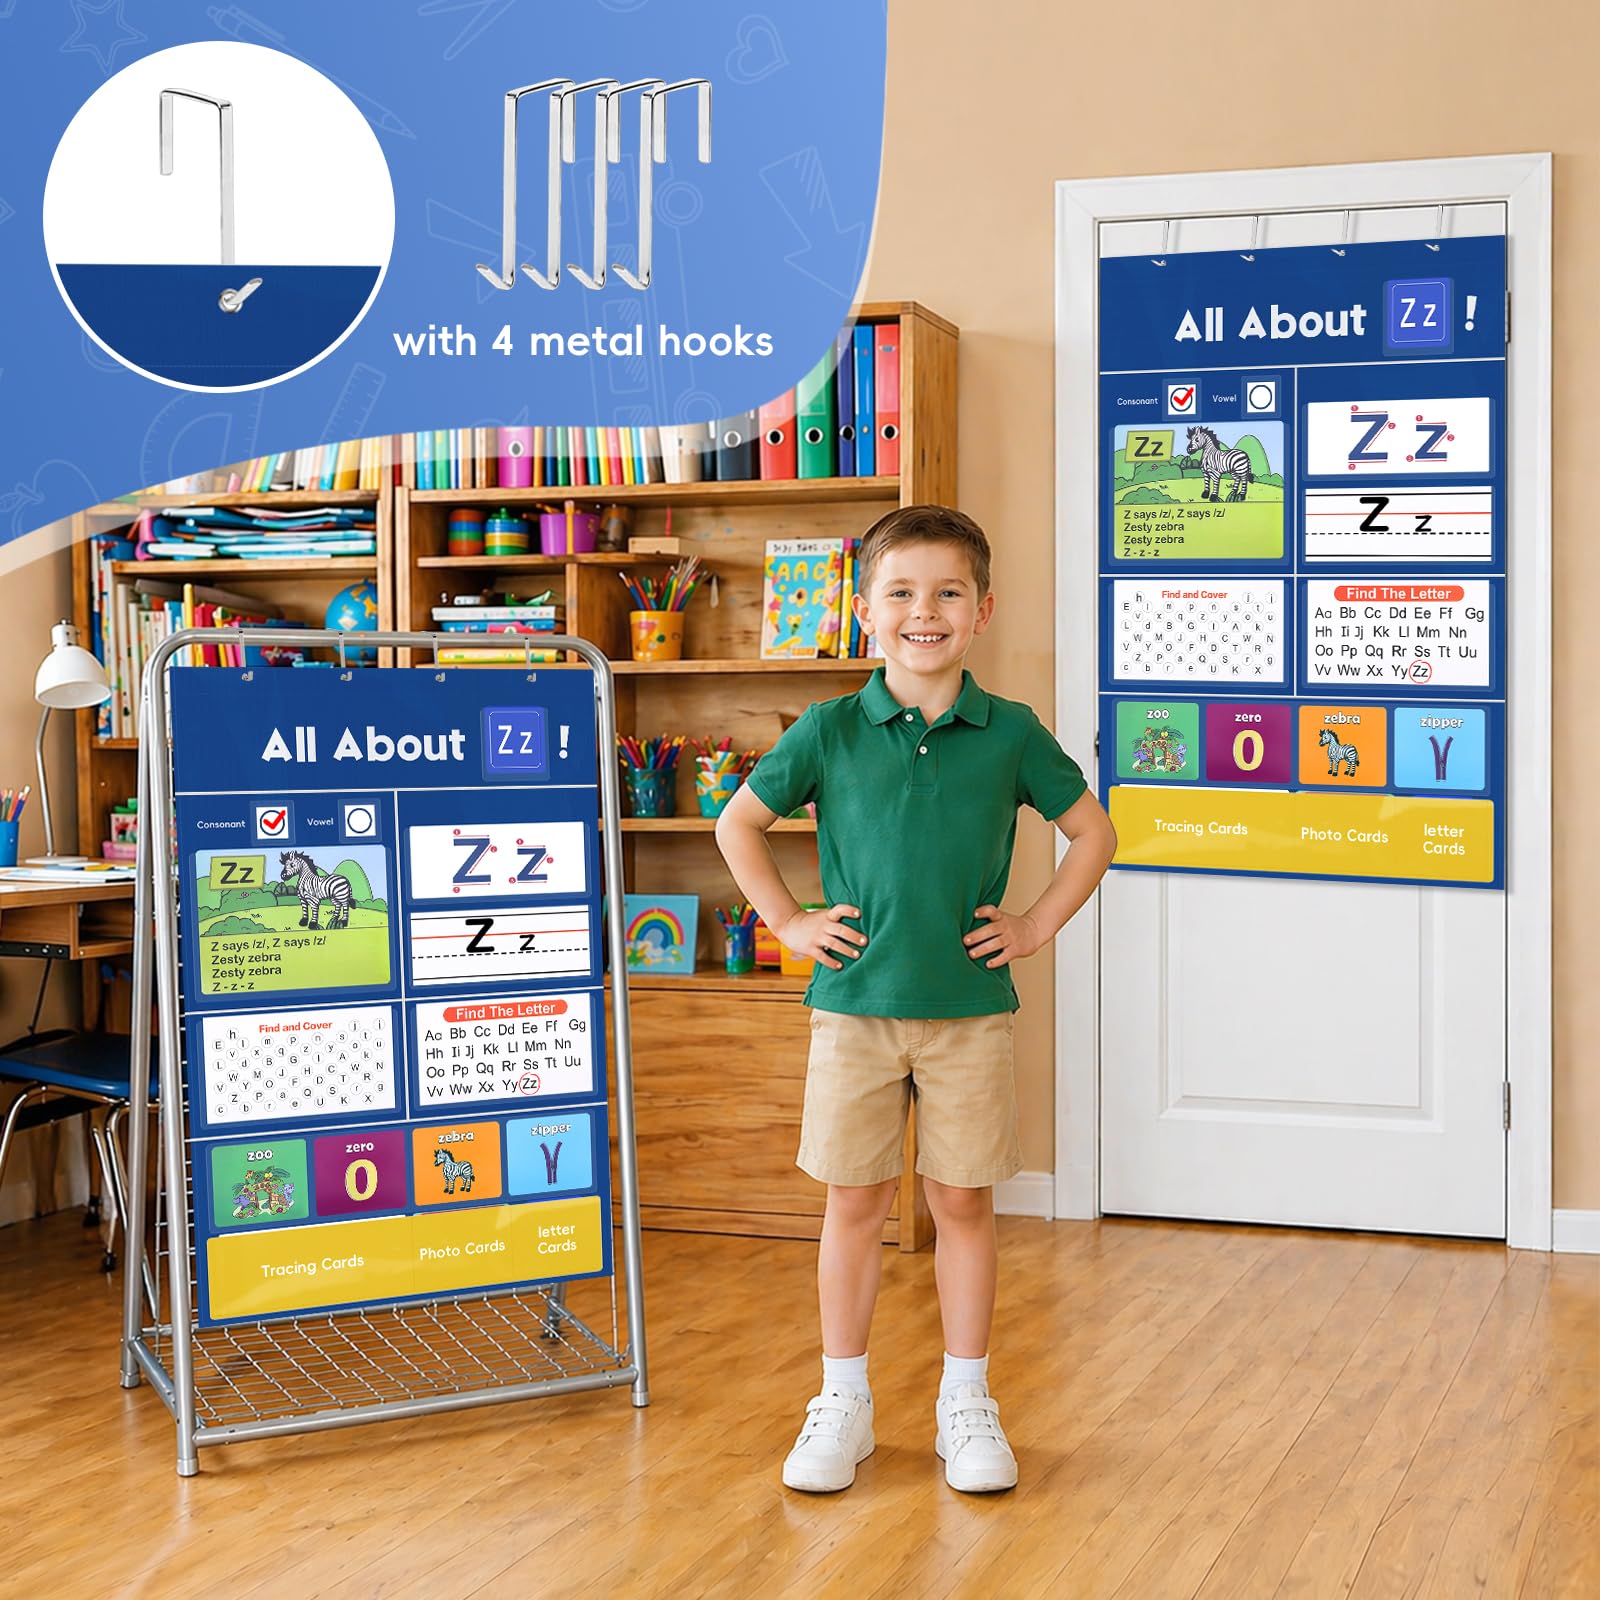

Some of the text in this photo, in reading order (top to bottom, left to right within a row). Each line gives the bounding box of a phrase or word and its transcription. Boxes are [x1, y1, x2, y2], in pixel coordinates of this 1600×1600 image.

[1175, 307, 1223, 342] All
[1239, 305, 1366, 339] About
[1465, 296, 1477, 331] !
[1348, 414, 1390, 460] Z
[1135, 437, 1163, 457] Zz
[1124, 508, 1225, 521] Z says /z/, Z says /z/
[1360, 497, 1391, 532] Z
[1124, 522, 1184, 533] Zesty zebra
[1124, 535, 1184, 546] Zesty zebra
[1124, 548, 1130, 556] Z
[1162, 590, 1180, 598] Find
[1183, 590, 1198, 598] and
[1347, 588, 1451, 599] Find The Letter
[1315, 607, 1331, 618] Aa
[1340, 607, 1356, 618] Bb
[1390, 607, 1406, 618] Dd
[1415, 607, 1431, 619] Ee
[1440, 607, 1452, 619] Ff
[1465, 608, 1484, 622] Gg
[1316, 626, 1332, 637] Hh
[1355, 626, 1363, 640] Jj
[1374, 626, 1389, 637] Kk
[1417, 626, 1440, 637] Mm
[1450, 627, 1466, 638] Nn
[1316, 645, 1476, 659] Oo Pp Qq Rr Ss Tt Uu
[1392, 665, 1408, 679] Yy
[1147, 709, 1169, 719] zoo
[1235, 714, 1261, 722] zero
[1325, 712, 1360, 724] zebra
[1420, 716, 1464, 729] zipper
[262, 727, 316, 762] All
[333, 726, 465, 761] About
[559, 726, 569, 758] !
[197, 821, 245, 829] Consonant
[1155, 819, 1248, 836] Tracing Cards
[1424, 824, 1464, 837] letter
[1302, 827, 1388, 843] Photo Cards
[1423, 841, 1465, 855] Cards
[453, 838, 493, 883] Z
[221, 863, 254, 884] Zz
[463, 918, 497, 953] Z
[211, 936, 326, 952] Z says /z/, Z says /z/
[212, 953, 281, 965] Zesty zebra
[213, 966, 281, 979] Zesty zebra
[213, 982, 220, 991] Z
[457, 1004, 555, 1019] Find The Letter
[259, 1022, 332, 1033] Find and Cover
[450, 1028, 466, 1039] Bb
[499, 1024, 514, 1035] Dd
[523, 1022, 537, 1033] Ee
[546, 1020, 557, 1032] Ff
[569, 1019, 585, 1032] Gg
[427, 1048, 443, 1059] Hh
[466, 1045, 473, 1059] Jj
[484, 1044, 499, 1054] Kk
[525, 1041, 546, 1051] Mm
[555, 1039, 571, 1049] Nn
[427, 1056, 581, 1078] Oo Pp Qq Rr Ss Tt Uu
[502, 1080, 518, 1092] Yy
[438, 1131, 474, 1144] zebra
[531, 1124, 571, 1137] zipper
[346, 1143, 374, 1152] zero
[247, 1150, 273, 1162] zoo
[539, 1225, 575, 1237] letter
[420, 1240, 505, 1260] Photo Cards
[538, 1239, 576, 1254] Cards
[261, 1255, 364, 1277] Tracing Cards
